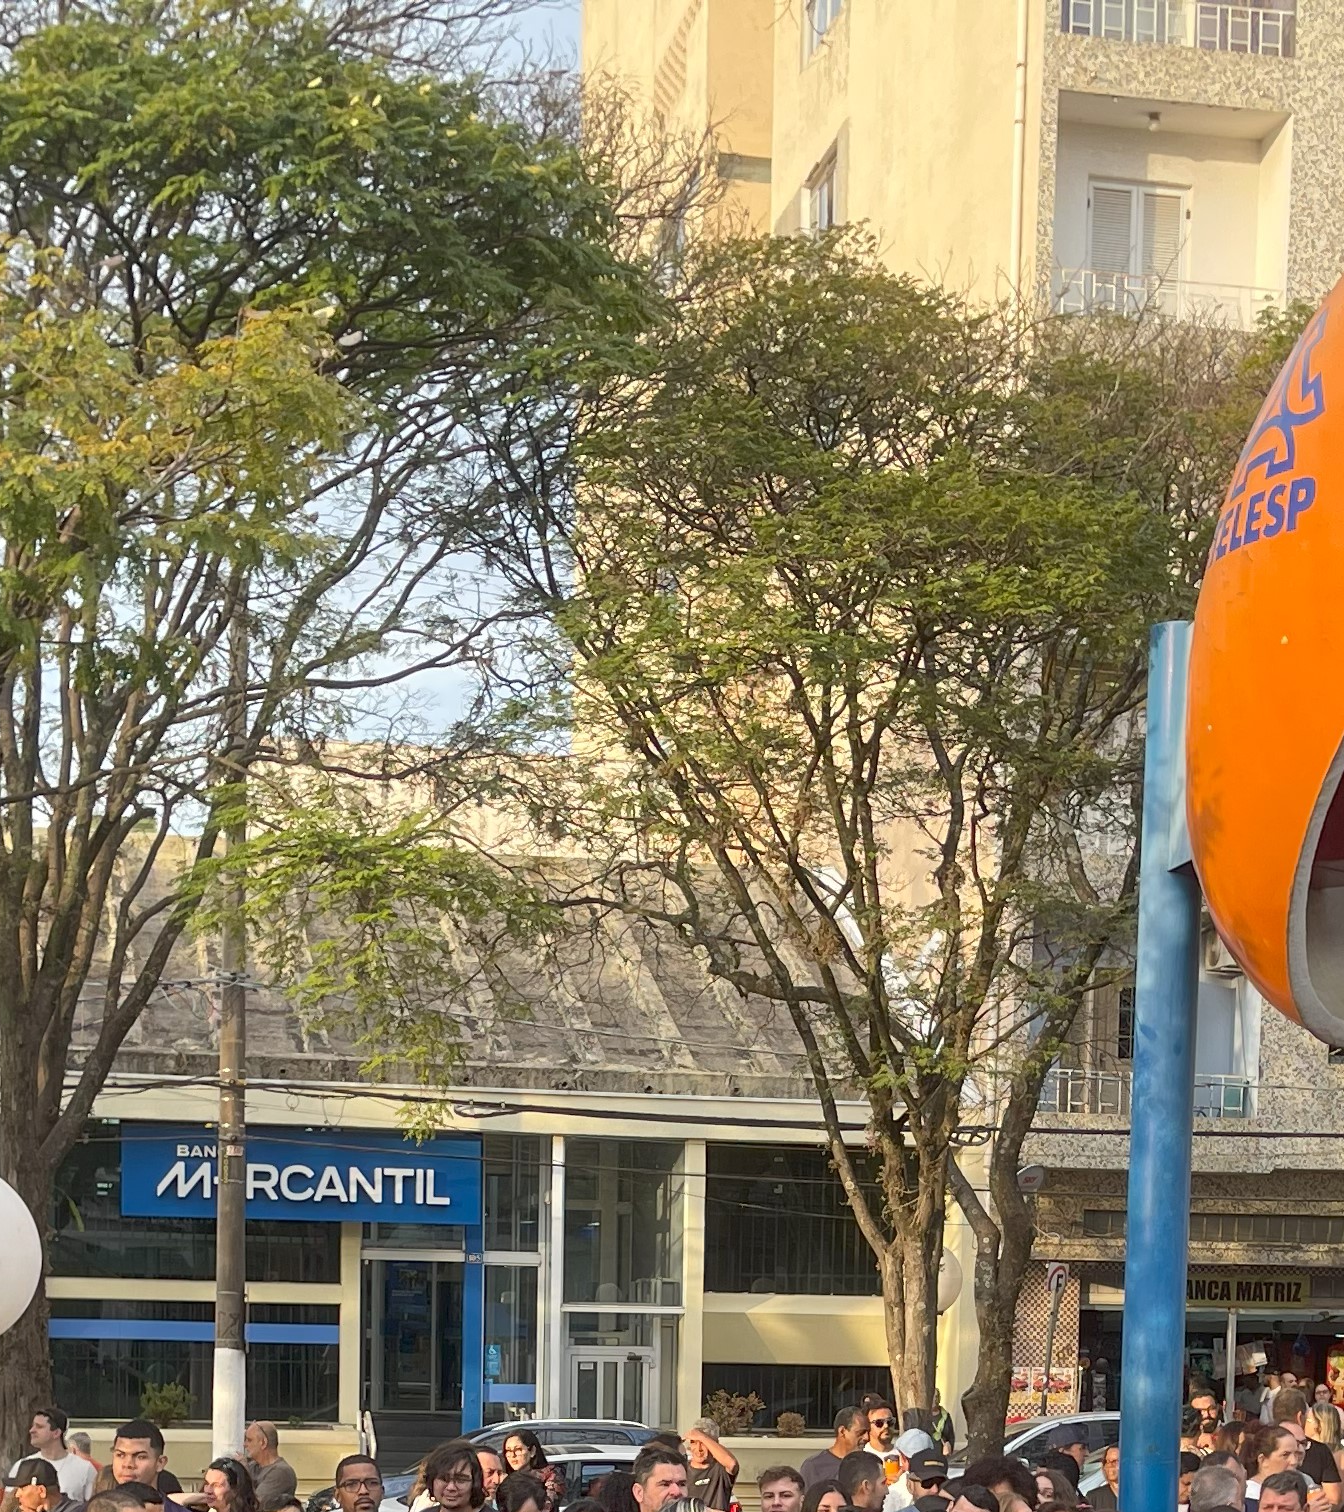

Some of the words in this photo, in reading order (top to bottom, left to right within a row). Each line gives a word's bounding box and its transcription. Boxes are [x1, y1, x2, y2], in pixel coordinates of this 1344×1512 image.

[176, 1144, 219, 1159] BAN
[156, 1160, 452, 1206] MRCANTIL
[1186, 1280, 1232, 1301] ANCA
[1236, 1281, 1302, 1303] MATRIZ
